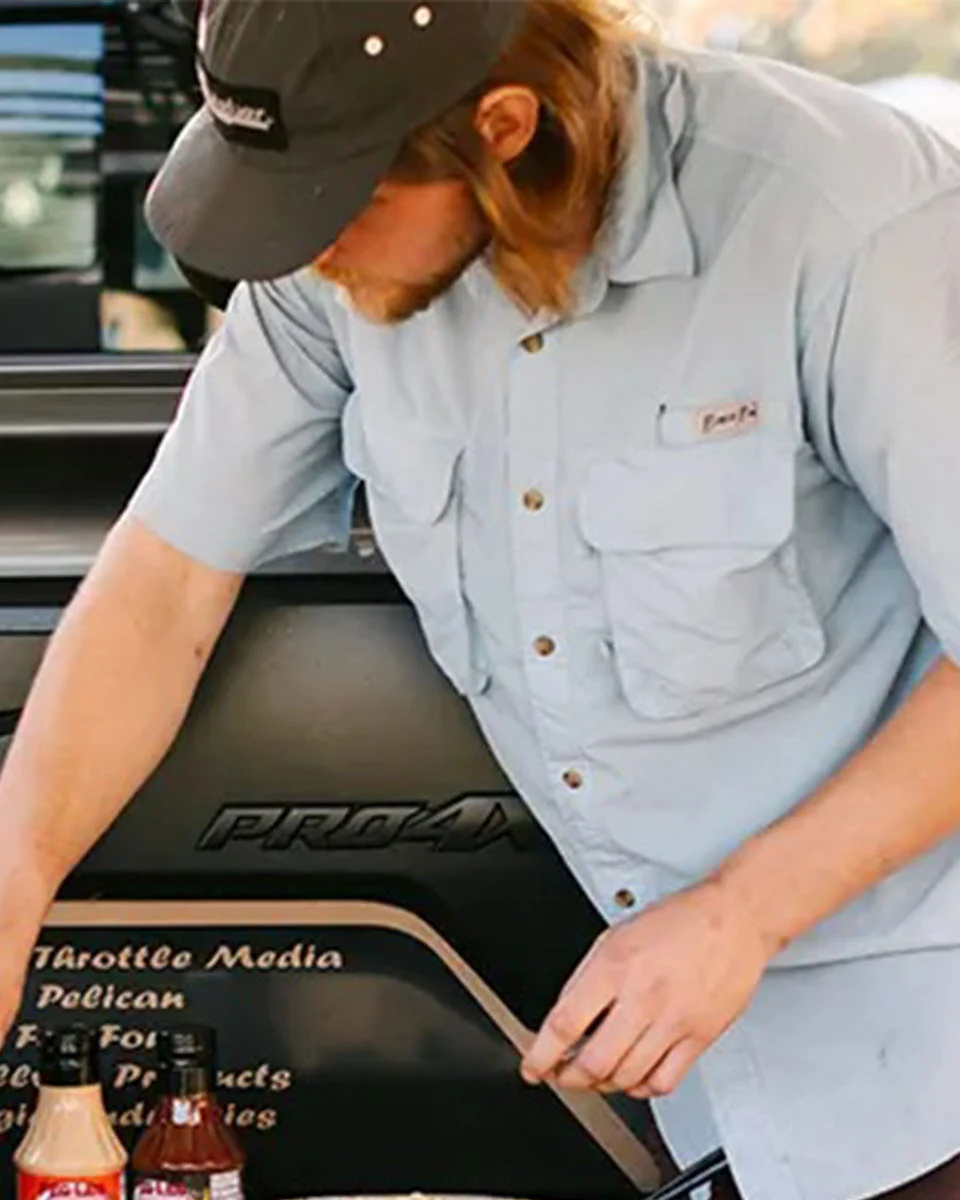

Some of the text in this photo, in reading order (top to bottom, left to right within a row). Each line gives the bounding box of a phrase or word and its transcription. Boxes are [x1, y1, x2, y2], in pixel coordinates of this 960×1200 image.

[35, 944, 344, 970] Throttle Media
[36, 983, 186, 1010] Pelican
[113, 1062, 293, 1092] Pructs
